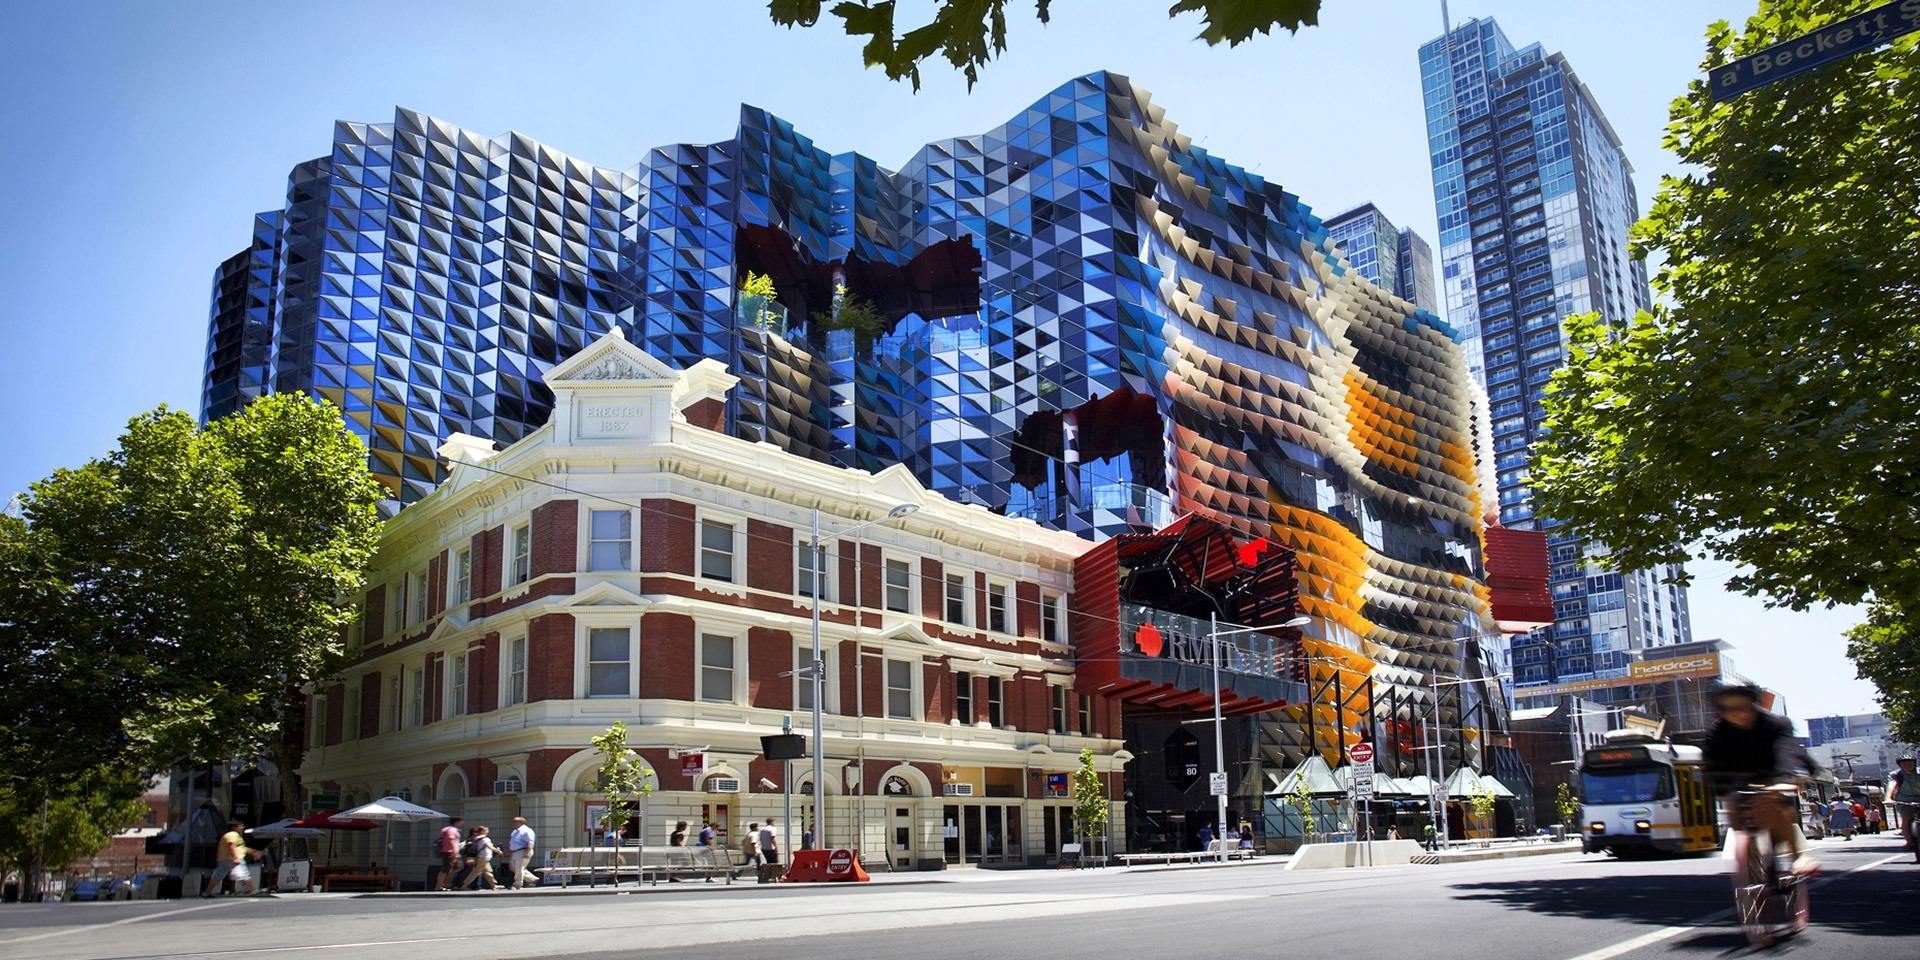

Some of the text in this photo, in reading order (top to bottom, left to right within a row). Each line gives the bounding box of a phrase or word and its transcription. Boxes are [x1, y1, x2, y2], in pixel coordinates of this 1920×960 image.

[586, 407, 643, 418] ERECTED
[600, 420, 629, 432] 1887
[1166, 628, 1241, 671] RMIT
[1634, 658, 1713, 674] hardrock
[1186, 768, 1197, 776] 80
[235, 806, 248, 815] 80
